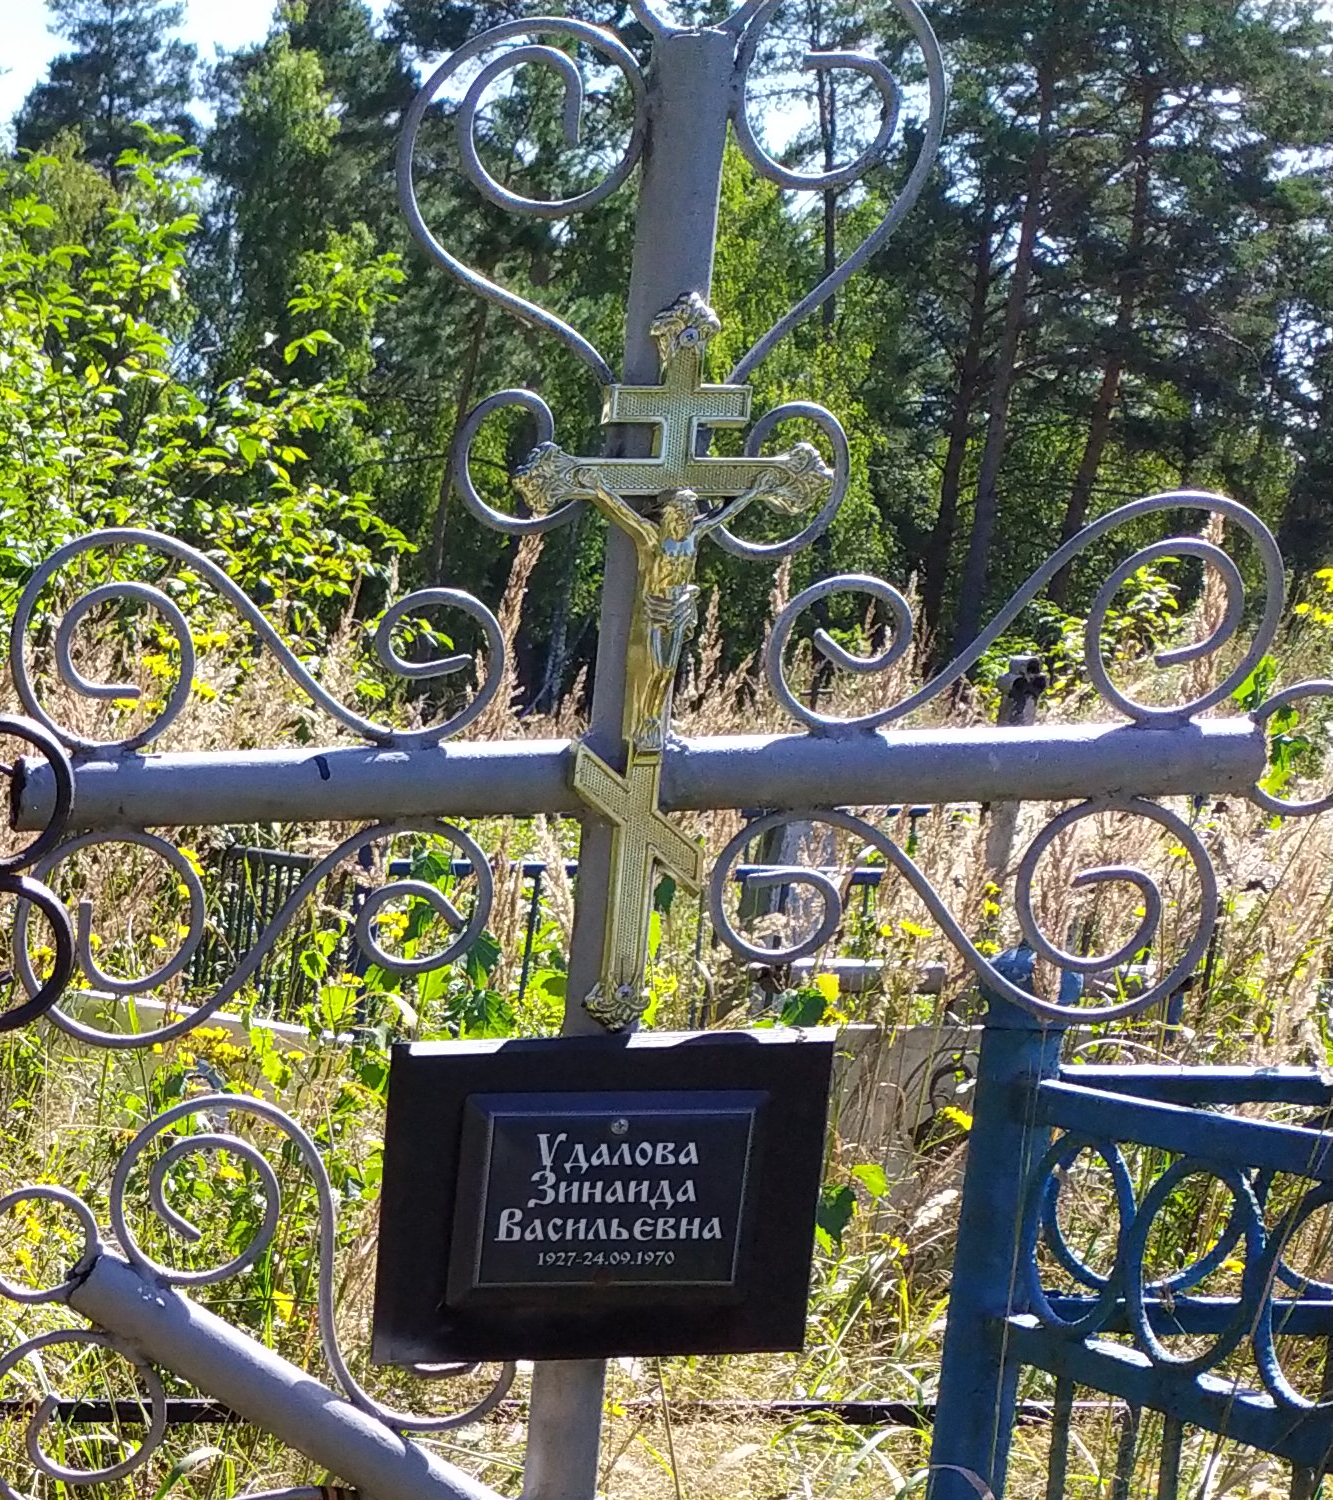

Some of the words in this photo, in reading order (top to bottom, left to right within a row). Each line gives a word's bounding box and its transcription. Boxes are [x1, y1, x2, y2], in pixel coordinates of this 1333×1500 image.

[536, 1133, 699, 1174] Удалова
[527, 1170, 697, 1209] Зинаида
[493, 1207, 724, 1242] Васильевна
[536, 1250, 676, 1267] 1927-24.09.1970
